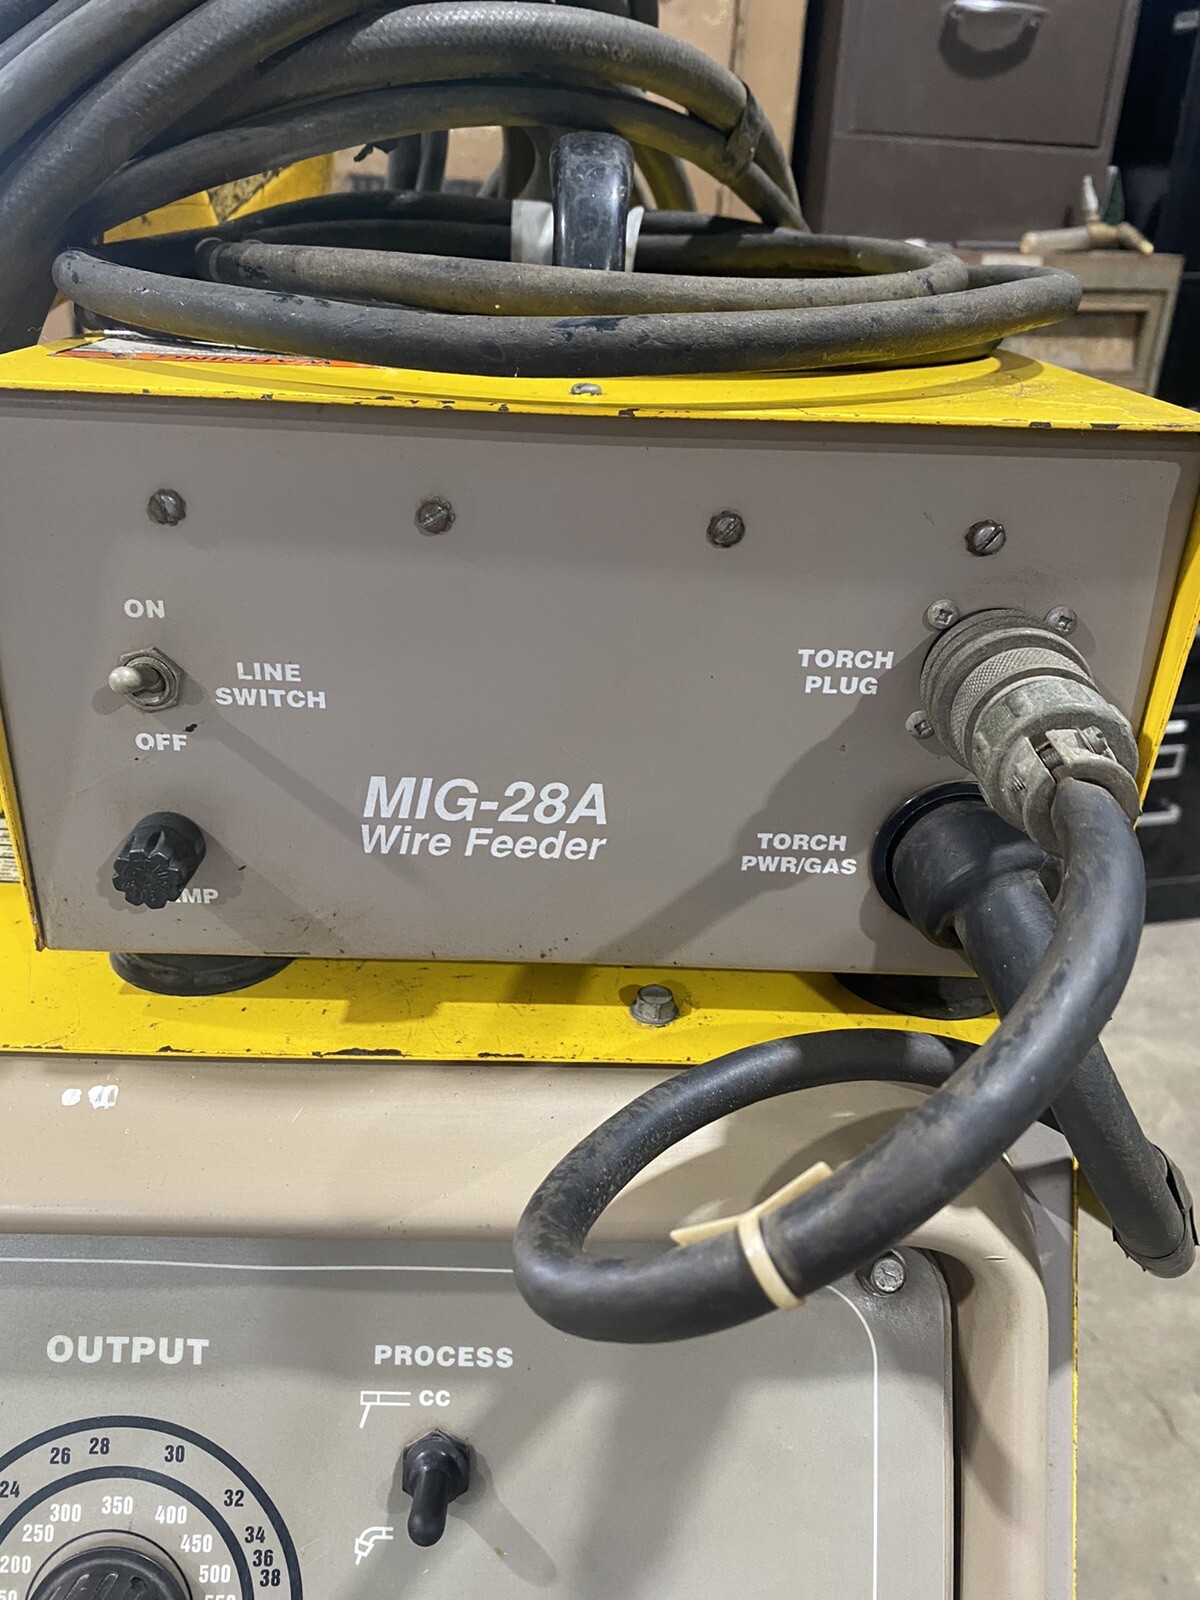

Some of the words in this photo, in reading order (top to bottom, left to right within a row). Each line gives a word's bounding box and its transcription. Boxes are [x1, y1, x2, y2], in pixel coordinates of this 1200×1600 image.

[124, 599, 165, 618] ON
[798, 649, 894, 669] TORCH
[236, 662, 301, 682] LINE
[805, 676, 878, 695] PLUG
[215, 687, 326, 709] SWITCH
[135, 733, 187, 751] OFF
[363, 776, 607, 824] MIG-28A
[361, 824, 451, 856] Wire
[464, 827, 607, 860] Feeder
[757, 833, 847, 852] TORCH
[741, 856, 857, 875] PWR/GAS
[168, 888, 218, 904] MP
[47, 1335, 209, 1365] OUTPUT
[374, 1345, 514, 1368] PROCESS
[419, 1390, 451, 1407] CC
[50, 1447, 71, 1464] 26
[89, 1437, 110, 1455] 28
[164, 1445, 185, 1463] 30
[0, 1480, 20, 1498] 24
[224, 1489, 244, 1507] 32
[50, 1504, 81, 1522] 300
[101, 1496, 133, 1515] 350
[155, 1505, 187, 1524] 400
[22, 1524, 54, 1542] 250
[245, 1526, 265, 1543] 34
[180, 1534, 212, 1552] 450
[0, 1555, 31, 1574] 200
[253, 1549, 273, 1567] 36
[199, 1564, 231, 1583] 500
[260, 1569, 280, 1587] 38
